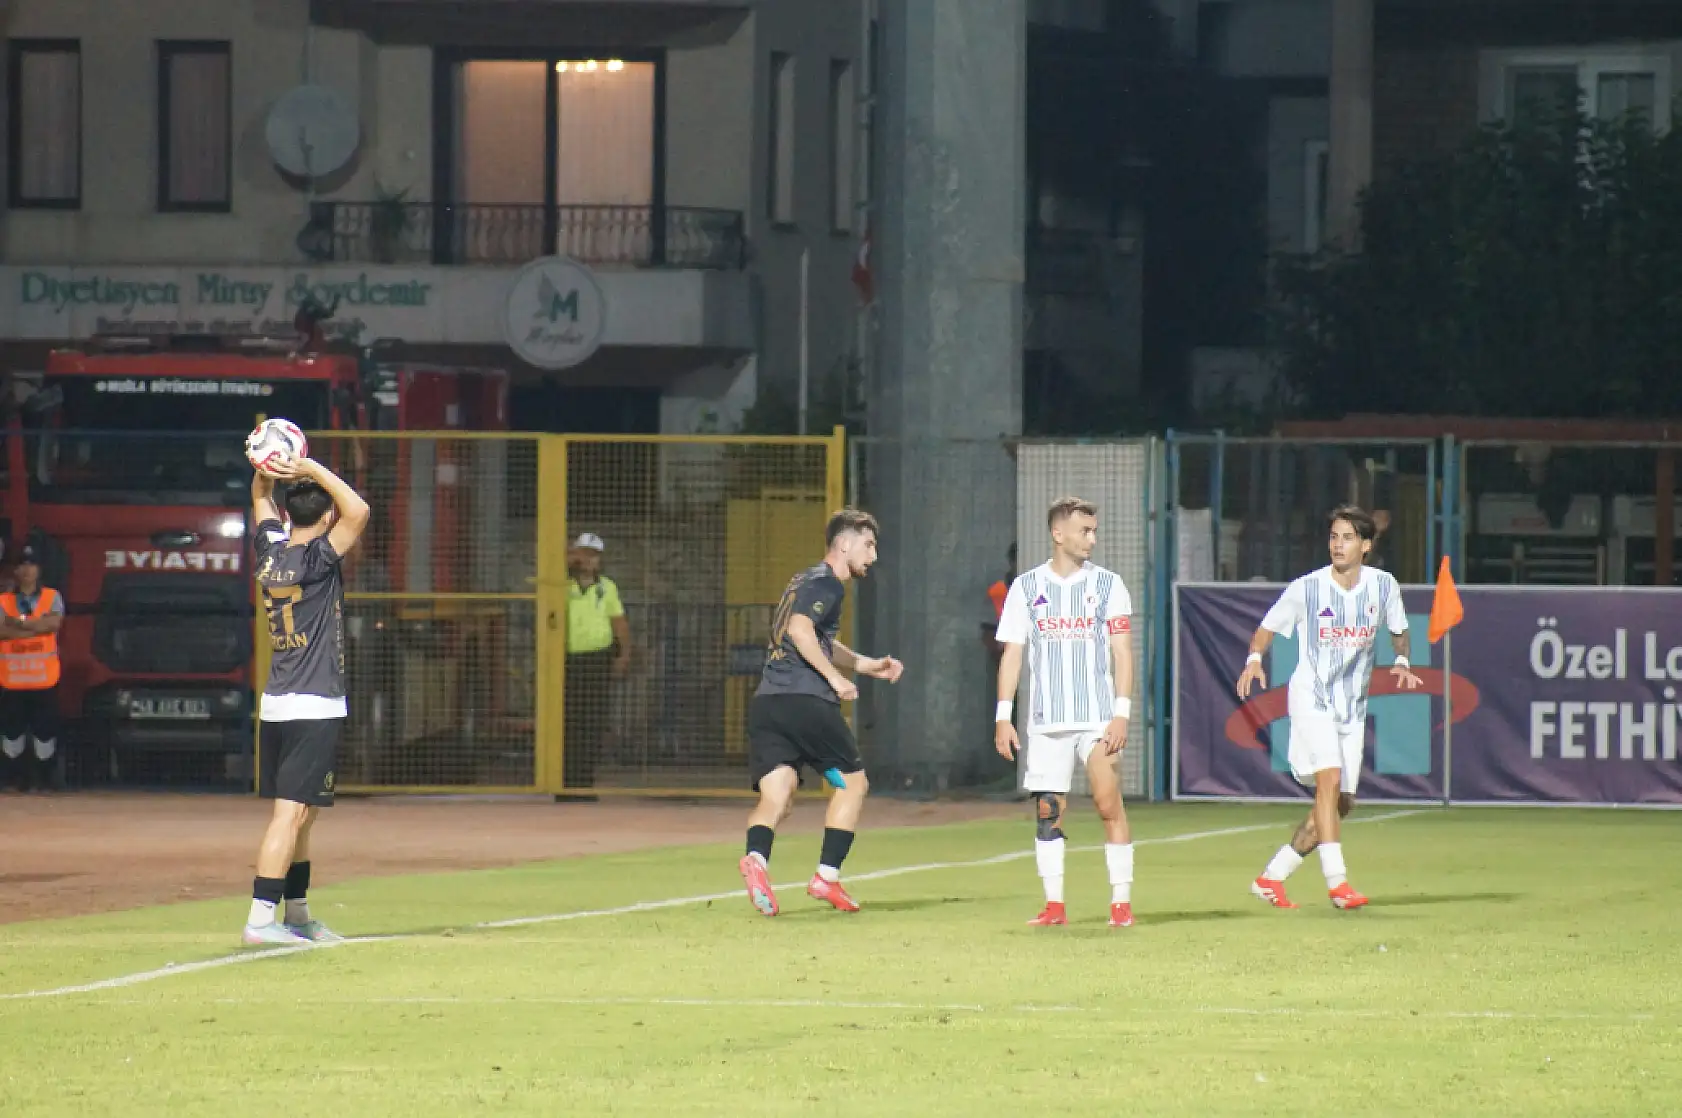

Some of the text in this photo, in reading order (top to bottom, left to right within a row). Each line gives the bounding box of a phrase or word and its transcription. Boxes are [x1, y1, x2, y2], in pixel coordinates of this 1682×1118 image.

[22, 272, 178, 316] Diyetisyen
[549, 288, 579, 323] M
[1037, 616, 1095, 631] ESNAF
[1530, 616, 1627, 679] Özel
[1530, 686, 1682, 760] FETHİ
